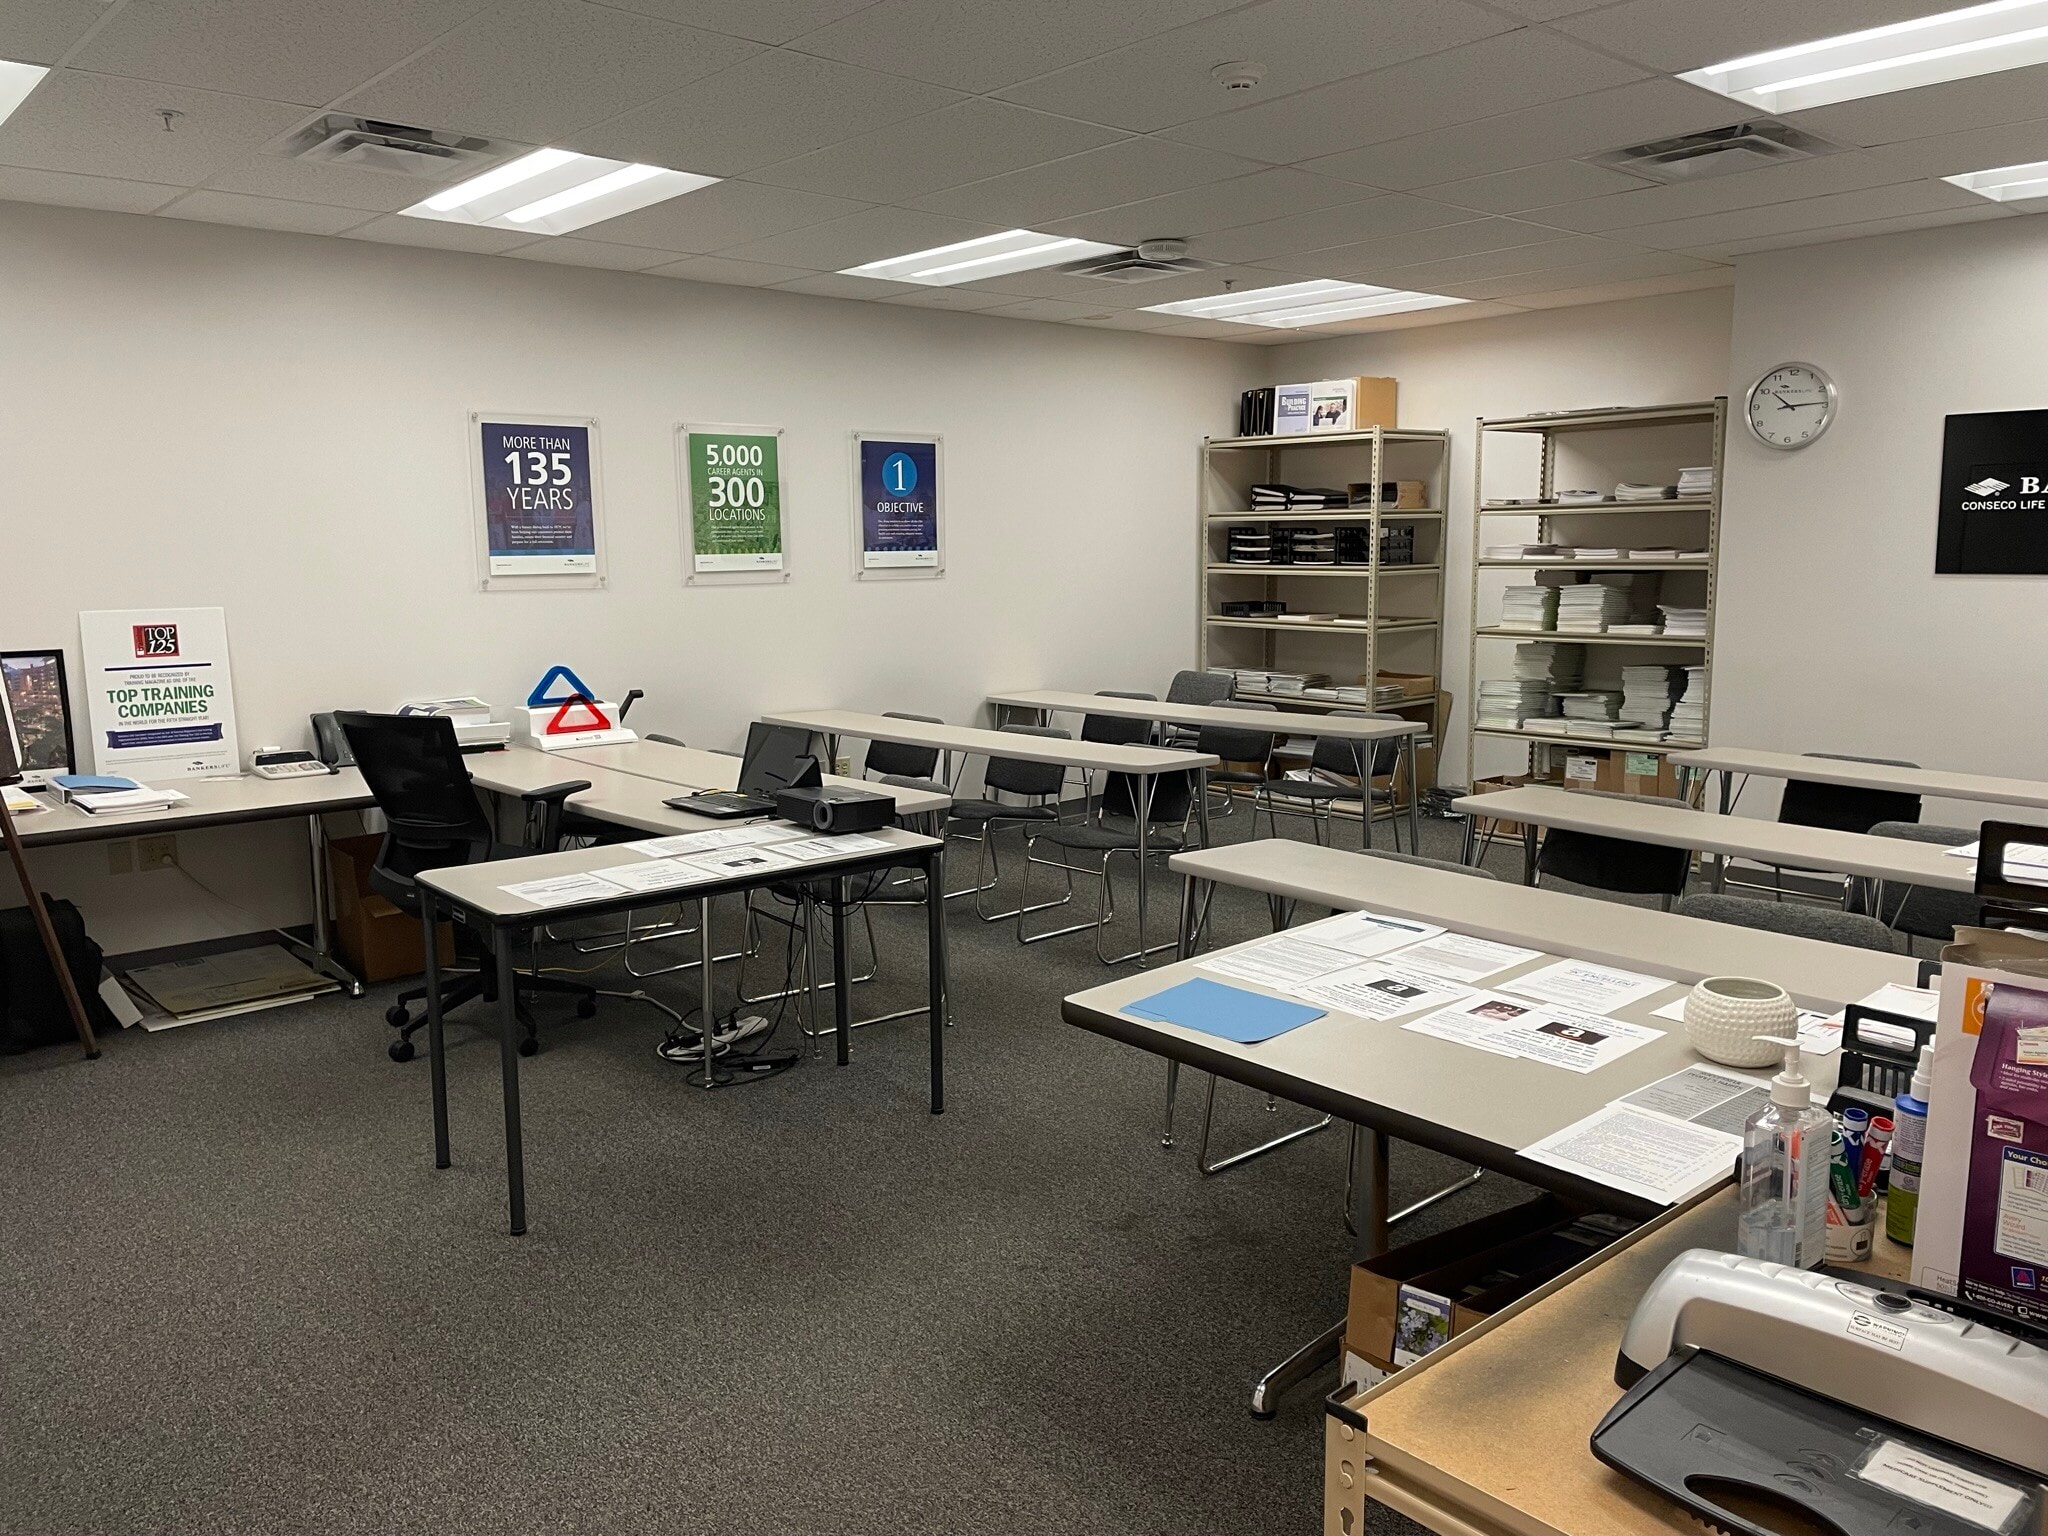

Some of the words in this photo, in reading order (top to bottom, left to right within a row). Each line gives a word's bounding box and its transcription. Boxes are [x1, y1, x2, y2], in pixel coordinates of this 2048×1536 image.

[503, 436, 537, 450] MORE
[539, 437, 570, 450] THAN
[706, 444, 763, 466] 5,000
[504, 451, 572, 486] 135
[708, 468, 731, 476] CAREER
[732, 468, 755, 476] AGENTS
[892, 460, 906, 491] 1
[506, 487, 573, 510] YEARS
[708, 476, 764, 507] 300
[877, 502, 924, 513] OBJECTIVE
[1961, 500, 2017, 510] CONSECO
[2020, 500, 2046, 510] LIFE
[709, 508, 766, 520] LOCATIONS
[144, 626, 174, 640] TOP
[147, 639, 176, 654] 125
[106, 689, 138, 704] TOP
[141, 685, 214, 701] TRAINING
[118, 700, 208, 718] COMPANIES
[2002, 1063, 2031, 1076] Hanging
[2007, 1150, 2028, 1162] Your
[1883, 1463, 1917, 1479] MEDICARE
[1919, 1477, 1963, 1497] SUPPLEMENT
